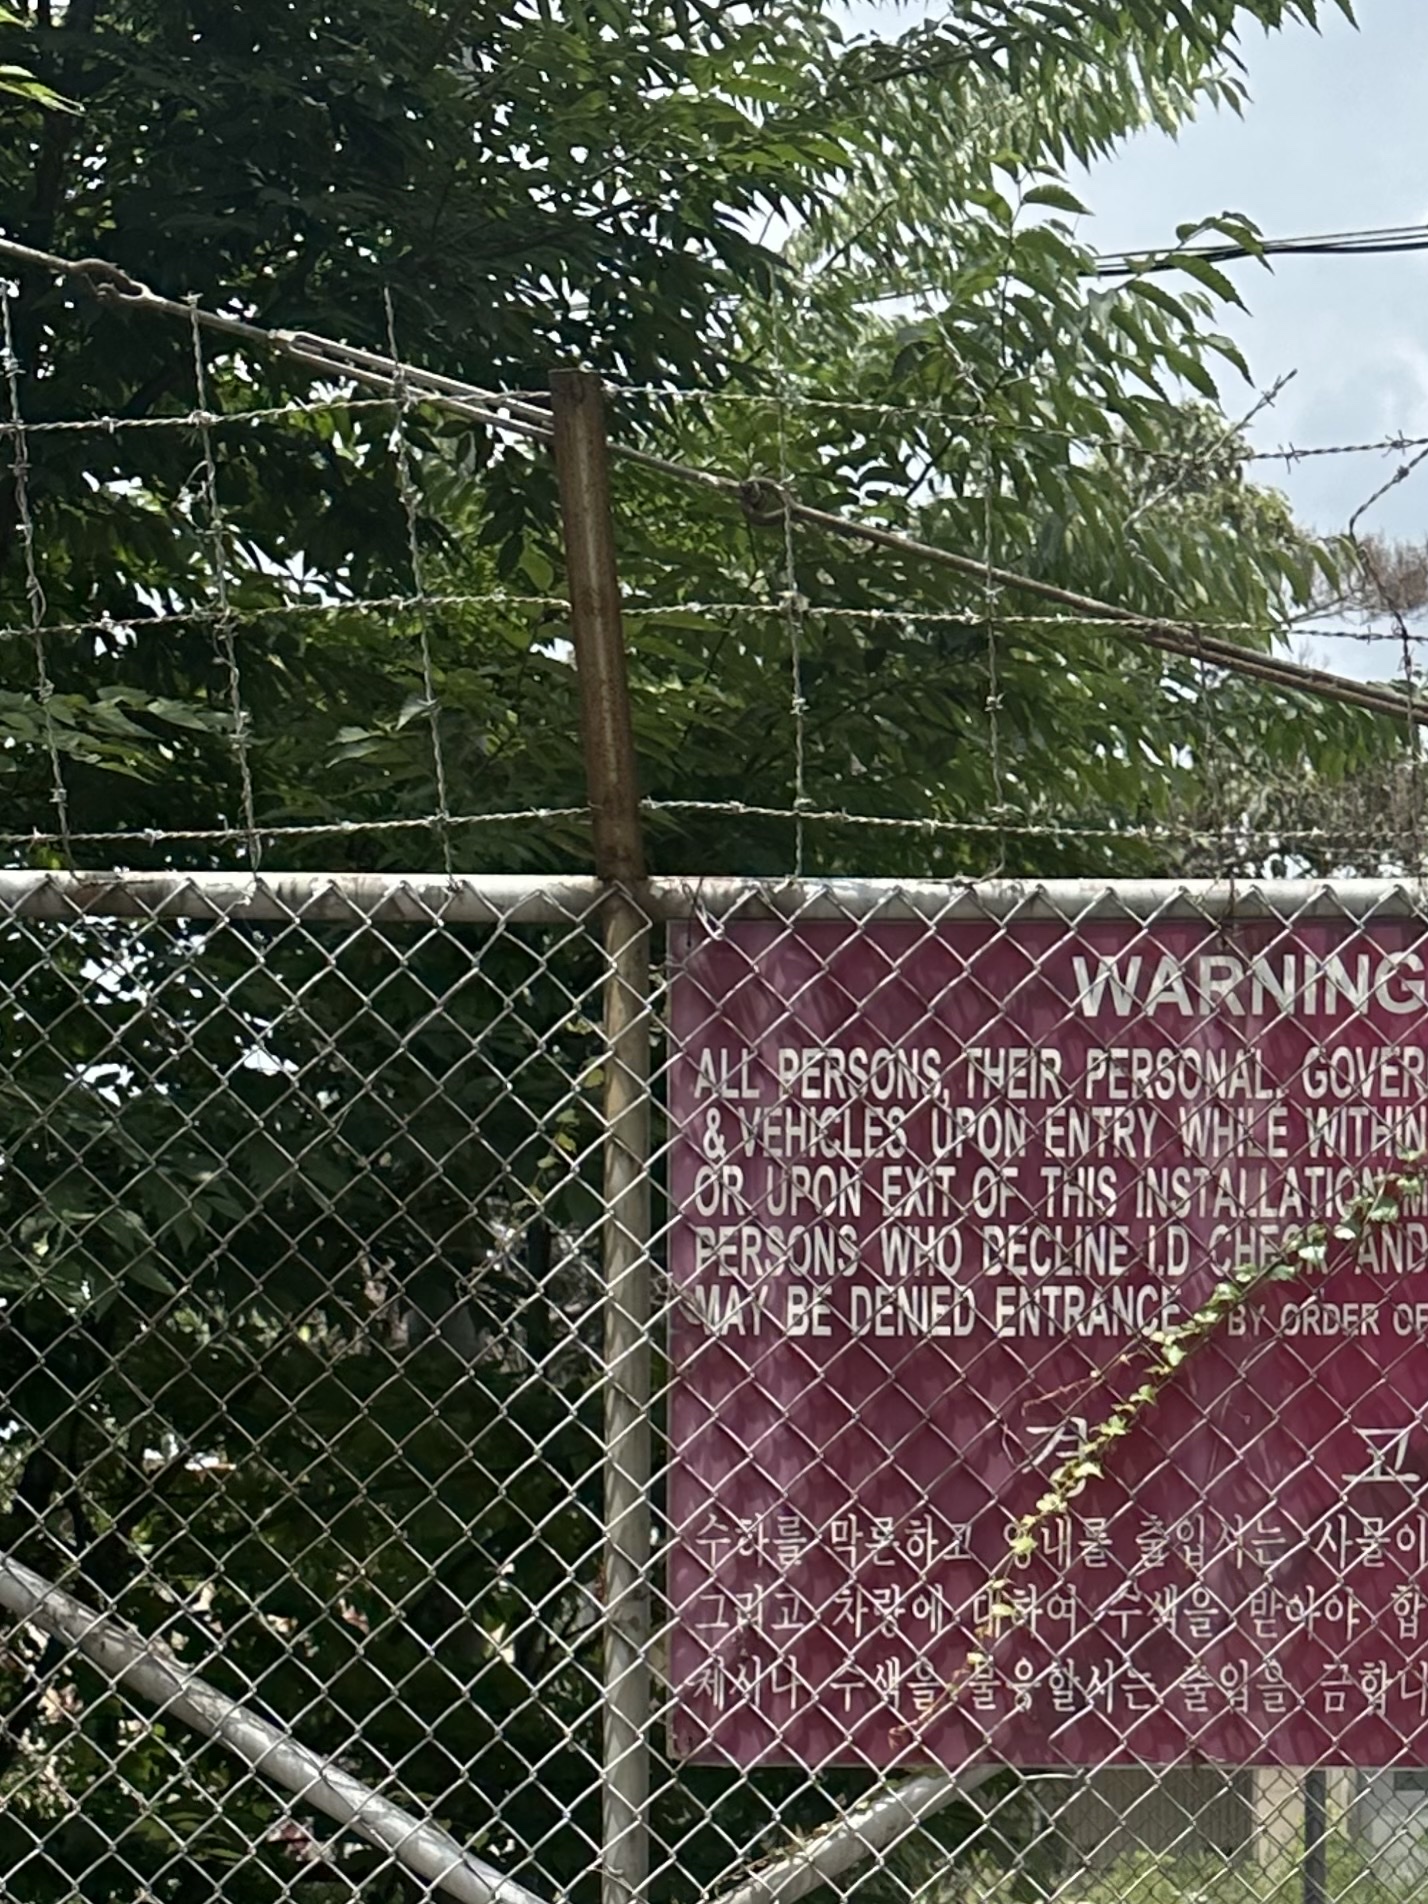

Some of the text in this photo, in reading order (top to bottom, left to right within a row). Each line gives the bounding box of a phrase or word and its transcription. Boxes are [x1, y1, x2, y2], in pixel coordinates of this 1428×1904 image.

[1072, 951, 1427, 1018] WARNING
[694, 1048, 760, 1099] ALL
[778, 1047, 951, 1108] PERSONS,
[966, 1047, 1063, 1099] THEIR
[702, 1107, 726, 1159] &
[741, 1107, 907, 1159] VEHICLES
[931, 1107, 1026, 1158] UPON
[1045, 1107, 1159, 1158] ENTRY
[1180, 1106, 1288, 1158] WHILE
[1305, 1105, 1427, 1158] WITHIN
[694, 1166, 744, 1217] OR
[766, 1166, 862, 1217] UPON
[881, 1166, 957, 1217] EXIT
[972, 1166, 1019, 1217] OF
[1040, 1166, 1118, 1217] THIS
[696, 1225, 857, 1277] PERSONS
[880, 1225, 962, 1277] WHO
[983, 1224, 1129, 1277] DECLINE
[695, 1285, 769, 1336] MAY
[787, 1285, 833, 1337] BE
[850, 1284, 976, 1337] DENIED
[1228, 1303, 1265, 1337] BY
[1281, 1303, 1381, 1337] ORDER
[1342, 1427, 1420, 1483] 고
[695, 1513, 807, 1567] 수하를
[695, 1583, 804, 1633] 그리고
[832, 1583, 944, 1639] 차량에
[1250, 1584, 1361, 1641] 받아야
